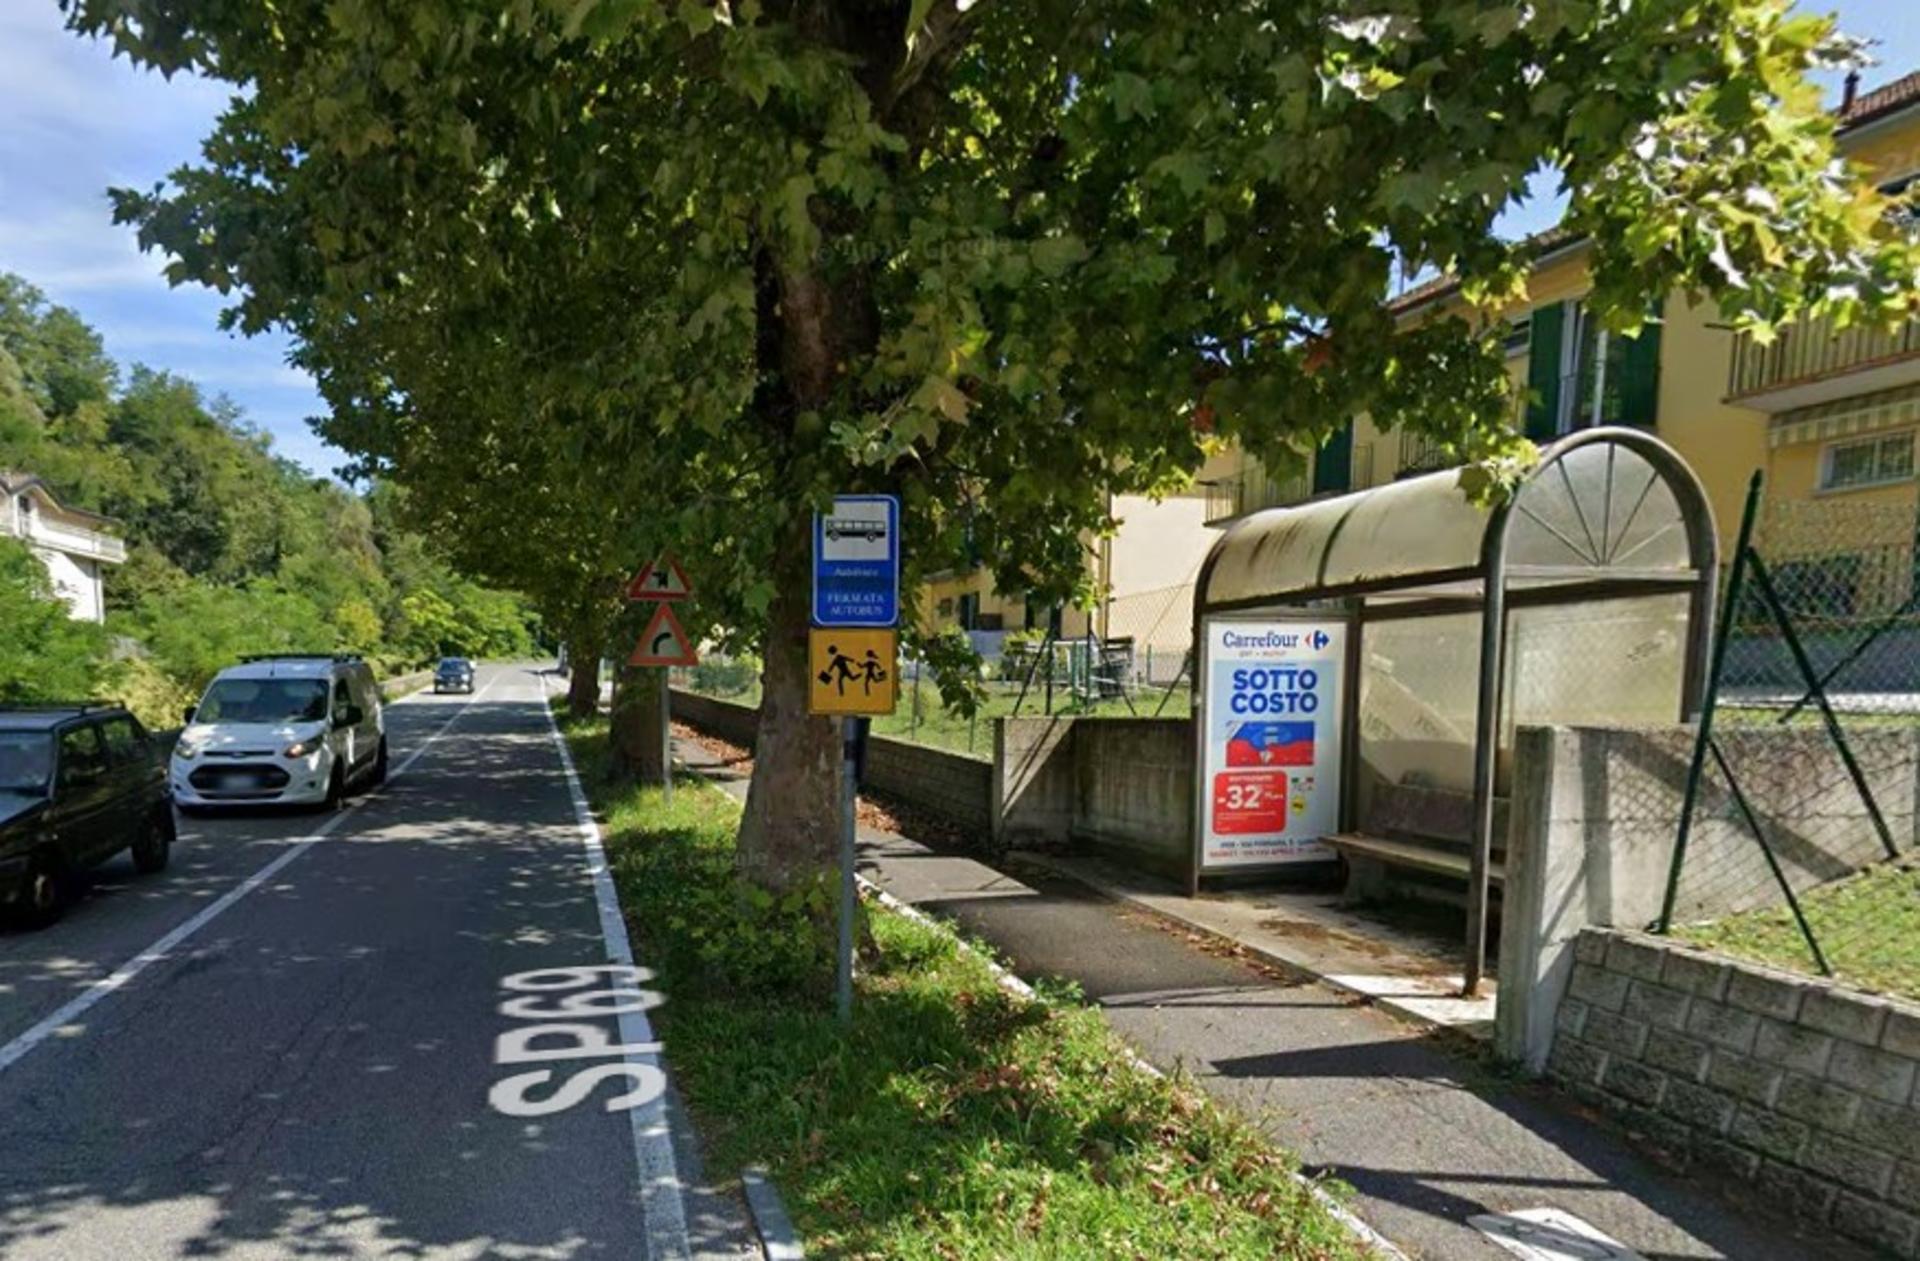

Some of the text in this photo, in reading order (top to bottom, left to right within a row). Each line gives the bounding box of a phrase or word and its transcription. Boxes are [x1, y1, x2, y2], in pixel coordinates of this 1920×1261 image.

[1222, 629, 1300, 649] Carrefour
[1232, 669, 1318, 691] SOTTO
[1230, 692, 1319, 714] COSTO
